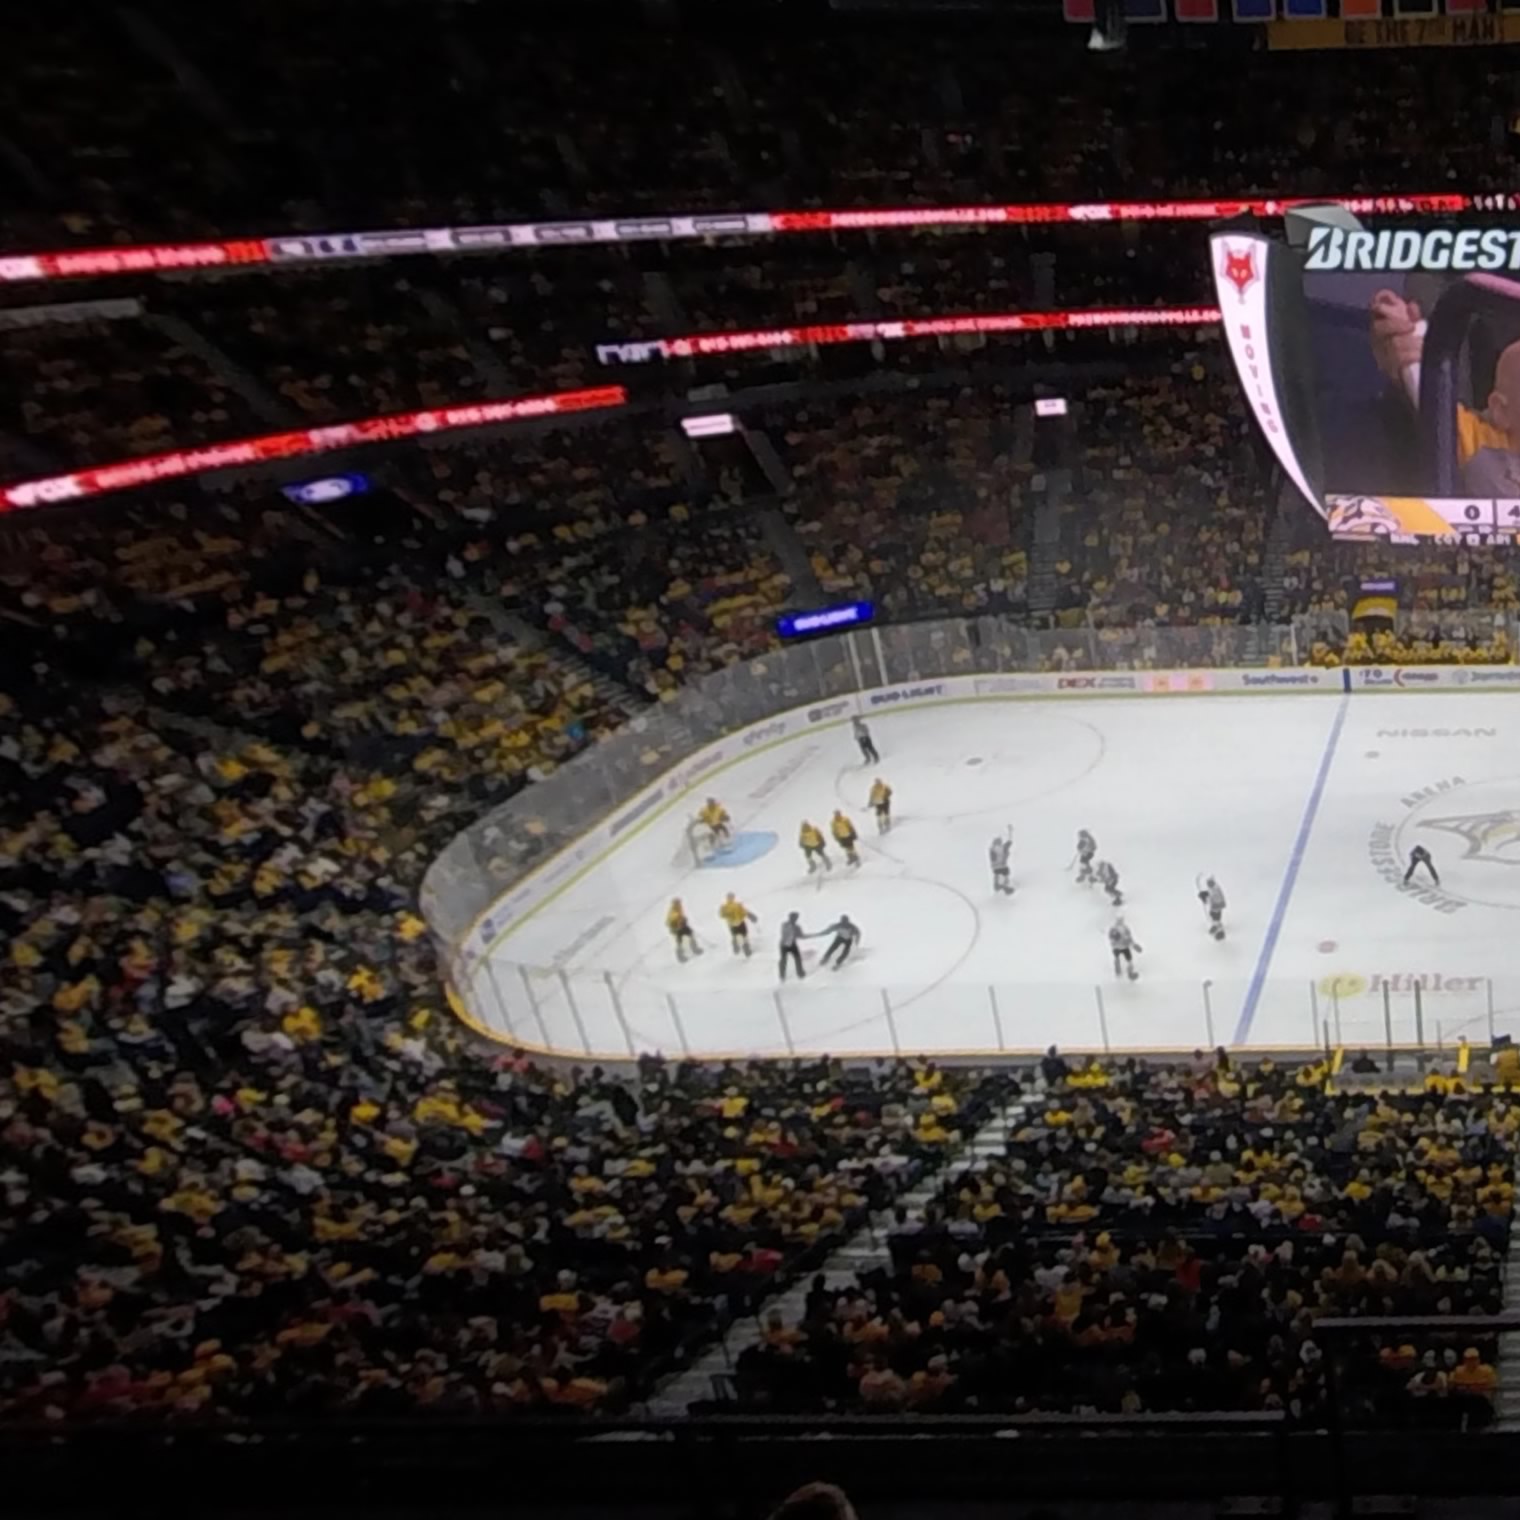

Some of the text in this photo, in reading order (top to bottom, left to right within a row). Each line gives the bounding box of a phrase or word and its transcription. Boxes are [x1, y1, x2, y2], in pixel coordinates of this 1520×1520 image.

[1057, 678, 1097, 689] DEX
[1242, 673, 1308, 685] Southwest
[1376, 727, 1497, 738] NISSAN
[1368, 974, 1484, 993] Hiller
